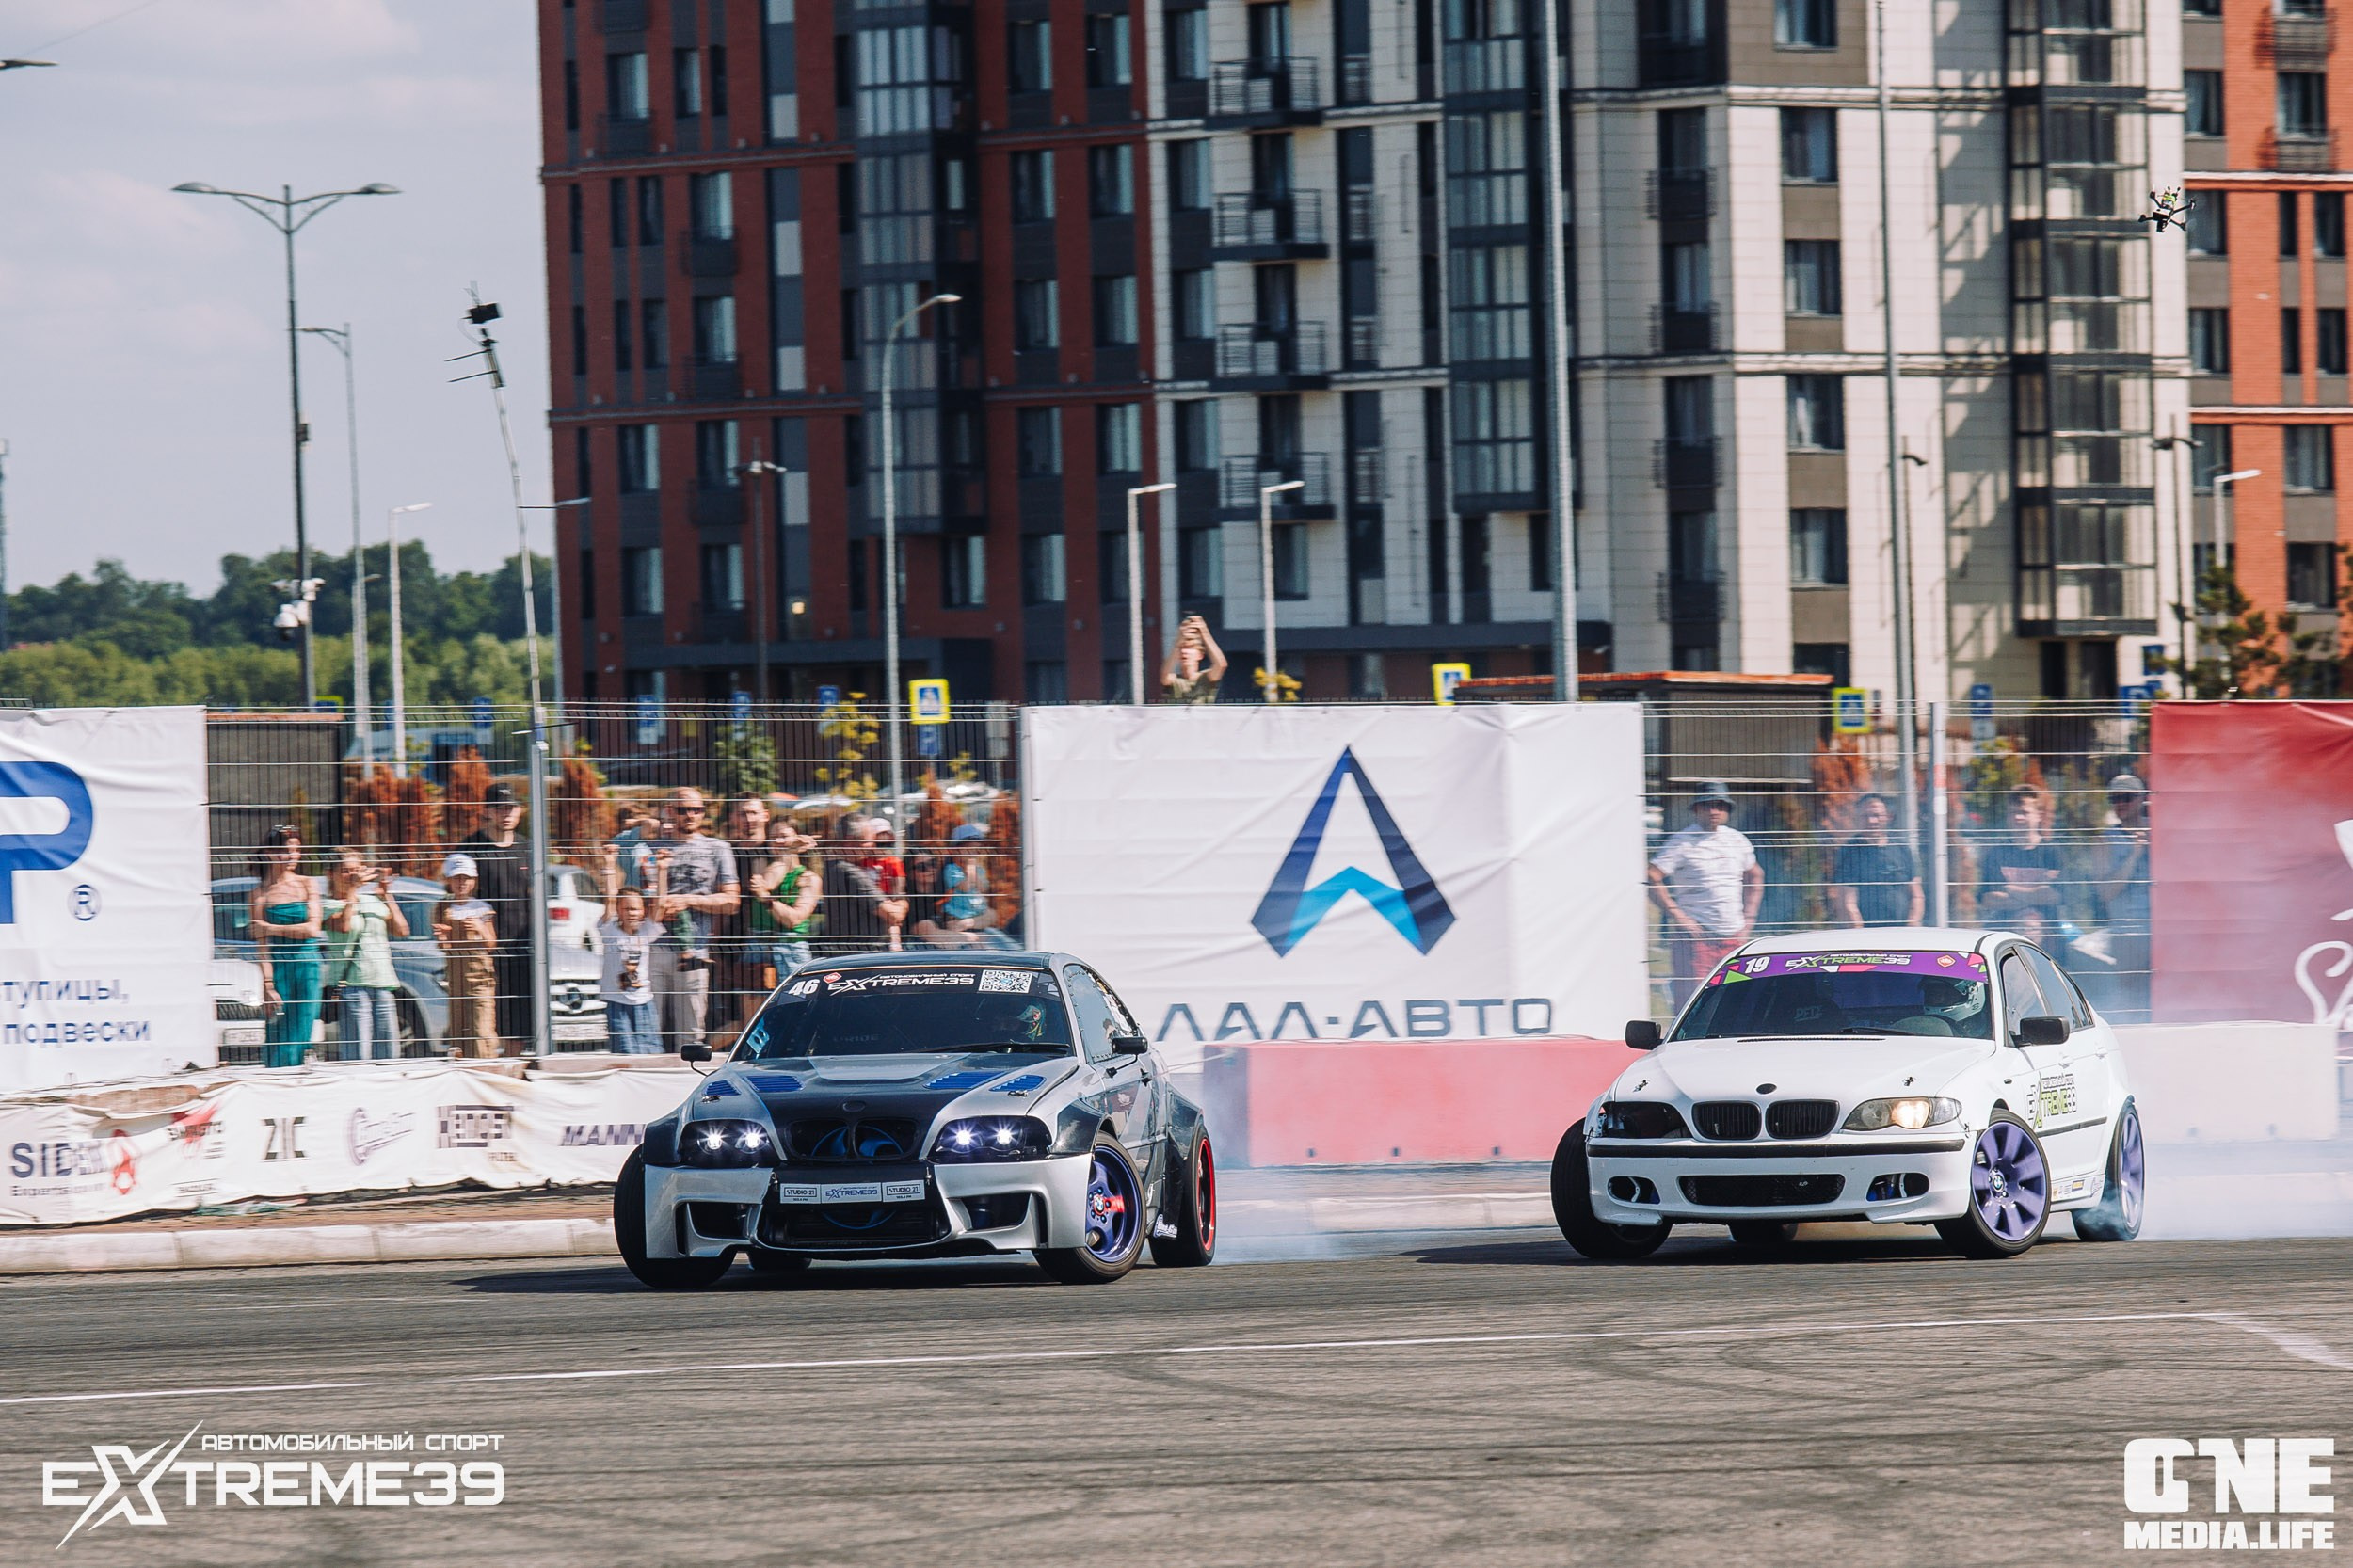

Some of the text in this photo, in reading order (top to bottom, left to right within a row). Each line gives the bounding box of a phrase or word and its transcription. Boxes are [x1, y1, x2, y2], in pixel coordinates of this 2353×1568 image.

[1745, 956, 1770, 974] 19
[0, 979, 129, 1009] тупицы,
[789, 979, 820, 996] 46
[827, 974, 975, 996] EXTREME39
[3, 1021, 151, 1048] подвески
[825, 1187, 878, 1201] EXTREME39
